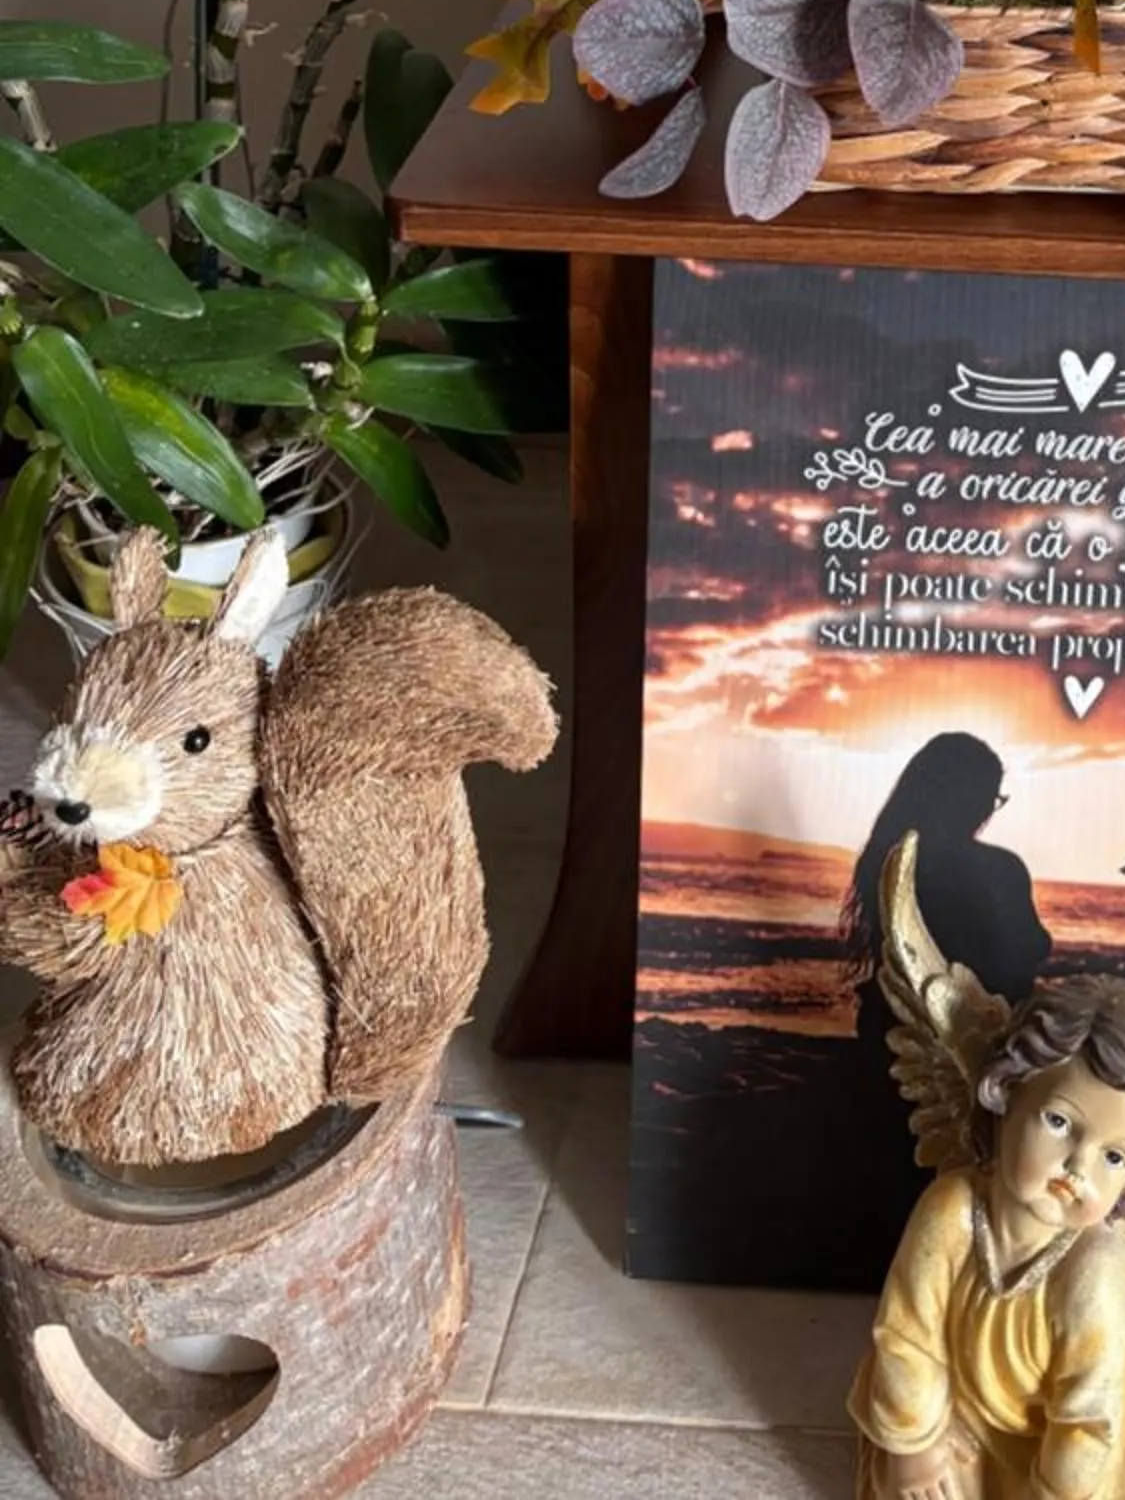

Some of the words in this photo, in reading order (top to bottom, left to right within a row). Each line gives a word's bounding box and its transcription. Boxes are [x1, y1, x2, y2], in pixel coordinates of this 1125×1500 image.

[864, 411, 936, 453] Cea
[948, 425, 1025, 458] mai
[916, 470, 947, 499] a
[959, 469, 1108, 506] oricărei
[822, 502, 891, 551] este
[905, 525, 1011, 557] aceea
[1026, 519, 1073, 560] că
[1087, 535, 1113, 562] o
[884, 572, 994, 613] poate
[819, 611, 1037, 657] schimbarea
